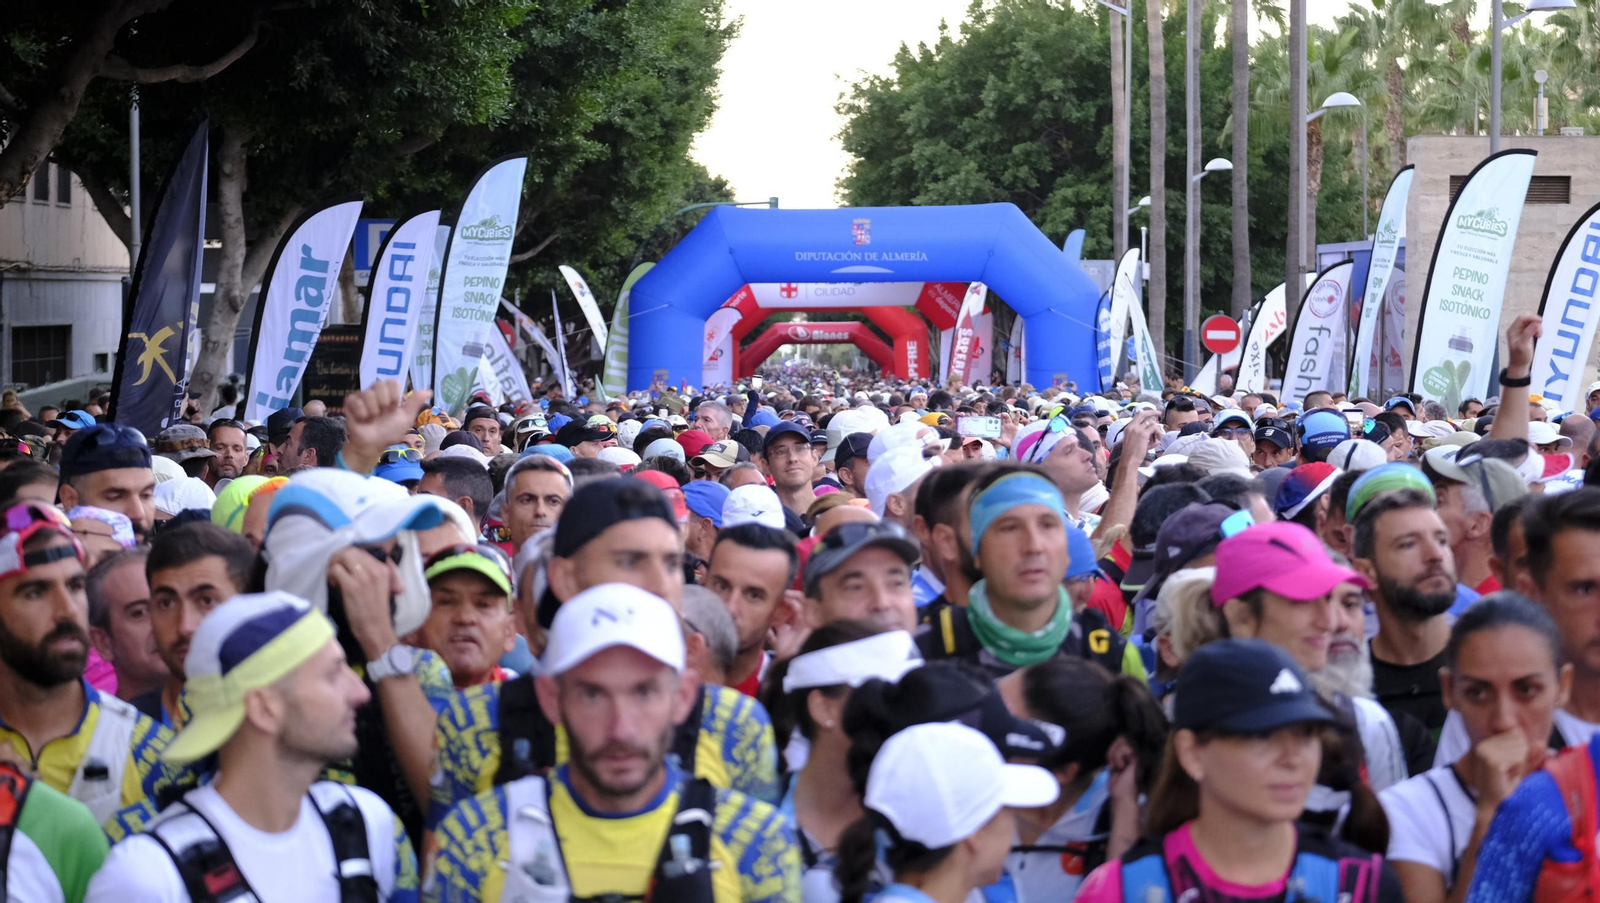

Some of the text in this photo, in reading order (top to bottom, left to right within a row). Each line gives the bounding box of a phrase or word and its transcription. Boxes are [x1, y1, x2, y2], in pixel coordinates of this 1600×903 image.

[795, 250, 928, 261] DIPUTACIÓN DE ALMERÍA
[463, 276, 500, 289] PEPINO
[1452, 266, 1489, 285] PEPINO
[464, 291, 497, 306] SNACK
[814, 287, 855, 296] CIUDAD
[1451, 284, 1485, 302] SNACK
[376, 241, 416, 378] UNDAI
[1439, 299, 1491, 320] ISOTÓNICO
[256, 243, 330, 414] iamar
[907, 340, 919, 378] PFRE
